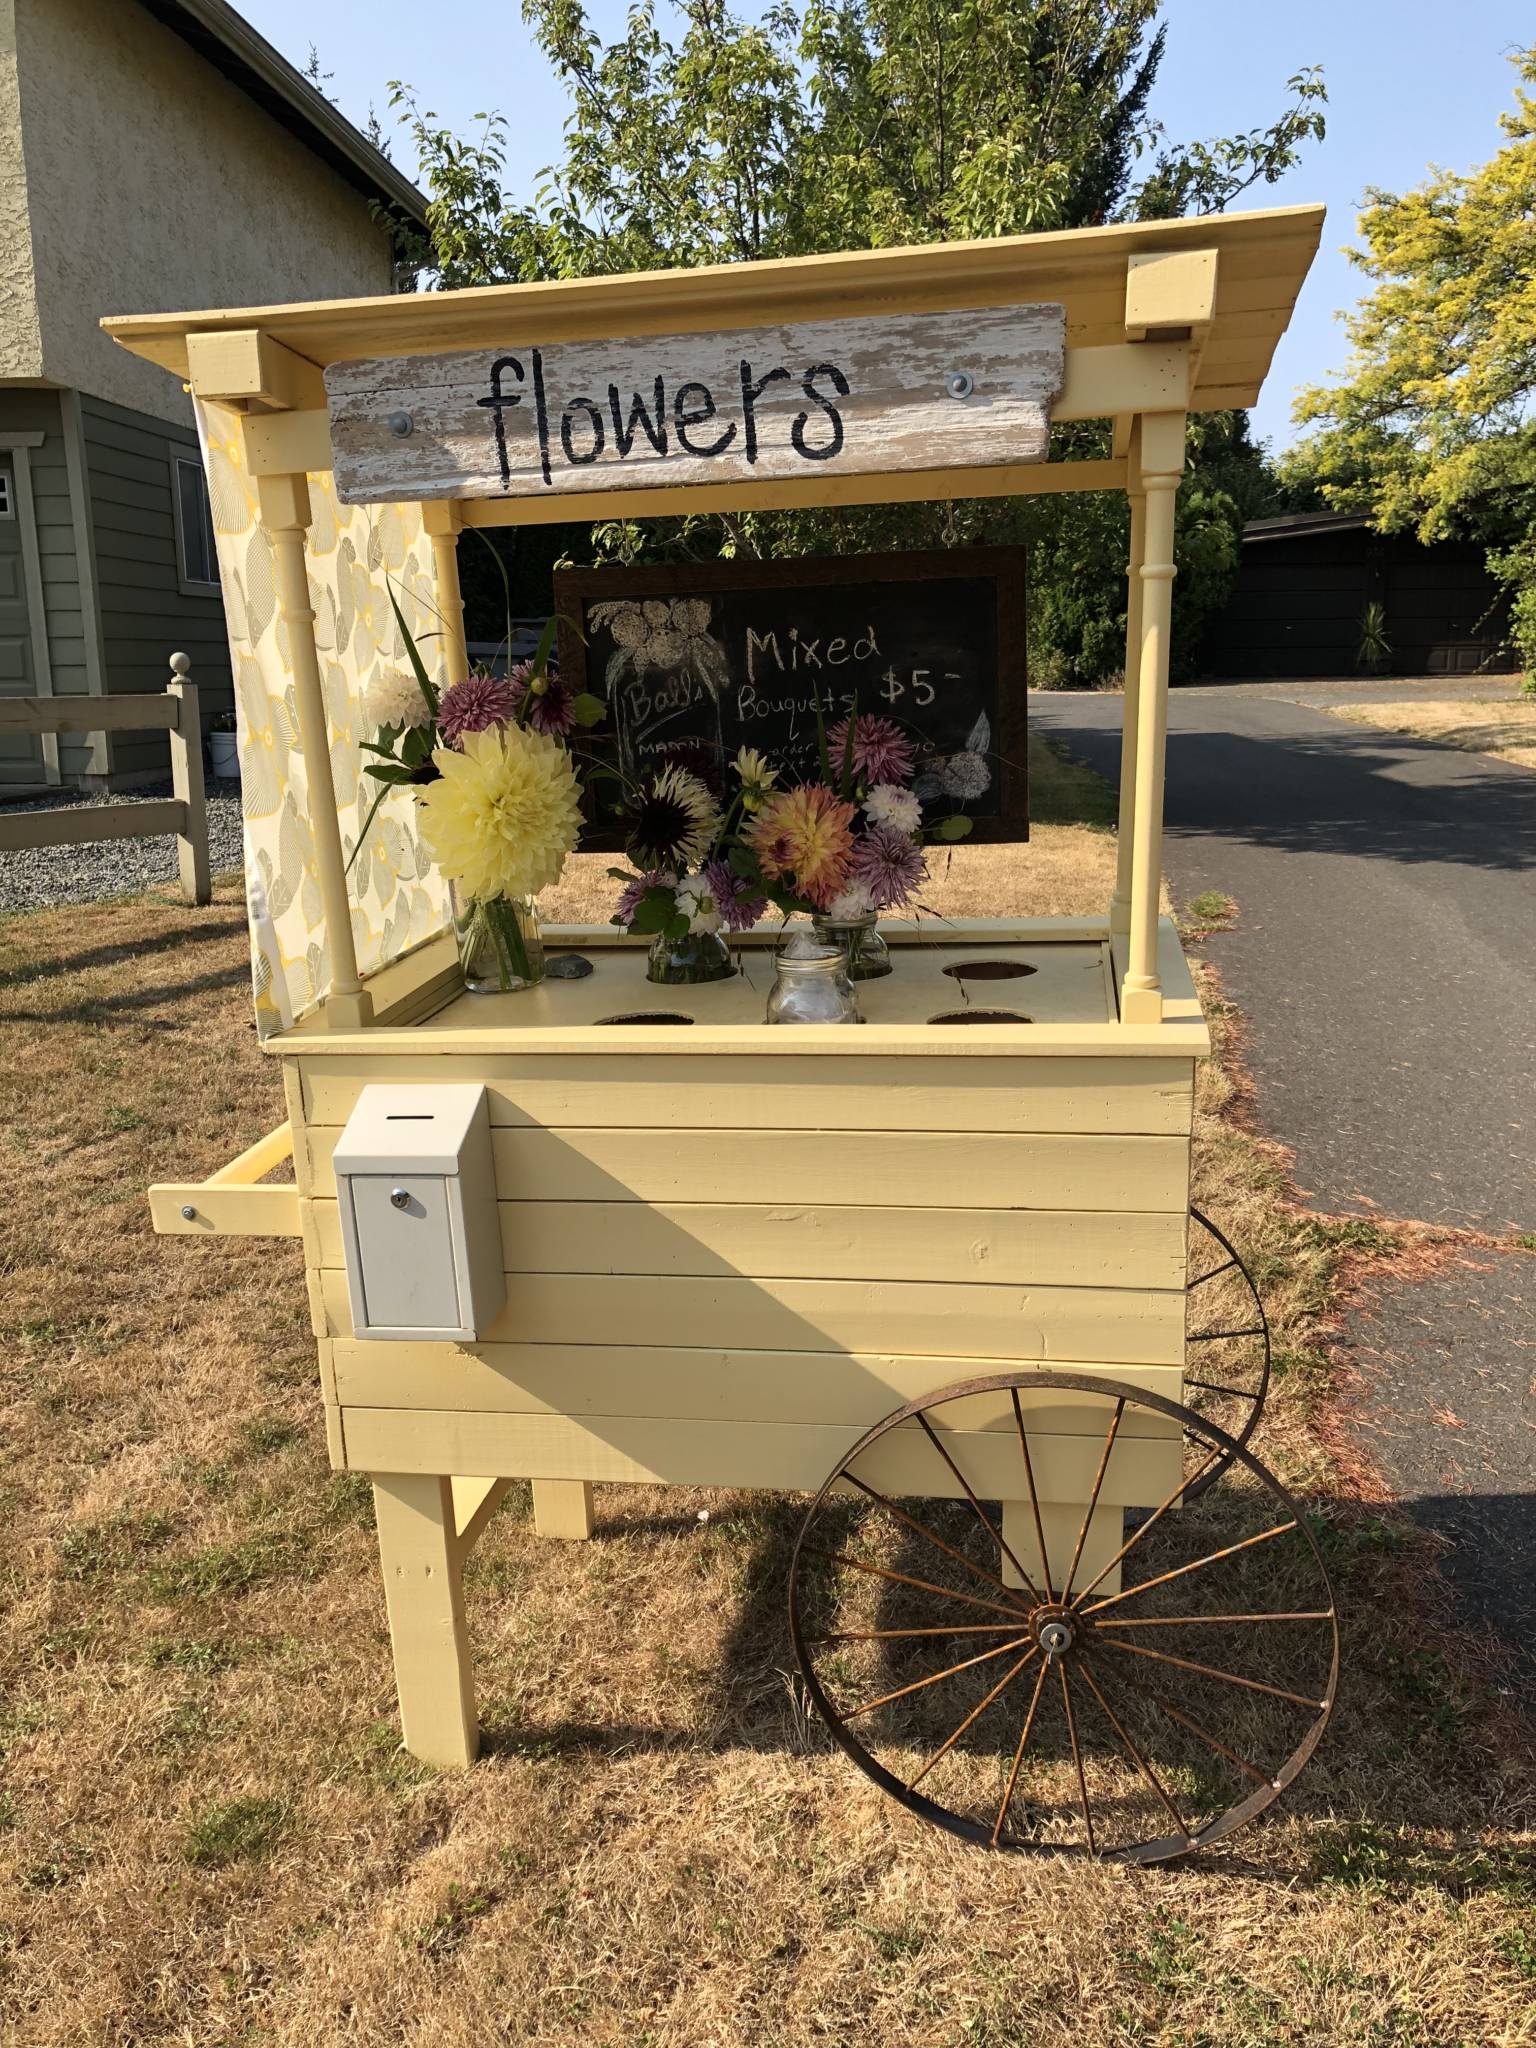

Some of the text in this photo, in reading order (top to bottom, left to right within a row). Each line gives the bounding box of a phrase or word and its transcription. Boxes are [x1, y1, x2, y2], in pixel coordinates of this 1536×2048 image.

[476, 347, 851, 491] flowers
[745, 624, 882, 684] Mixed
[736, 684, 858, 741] Bouquets
